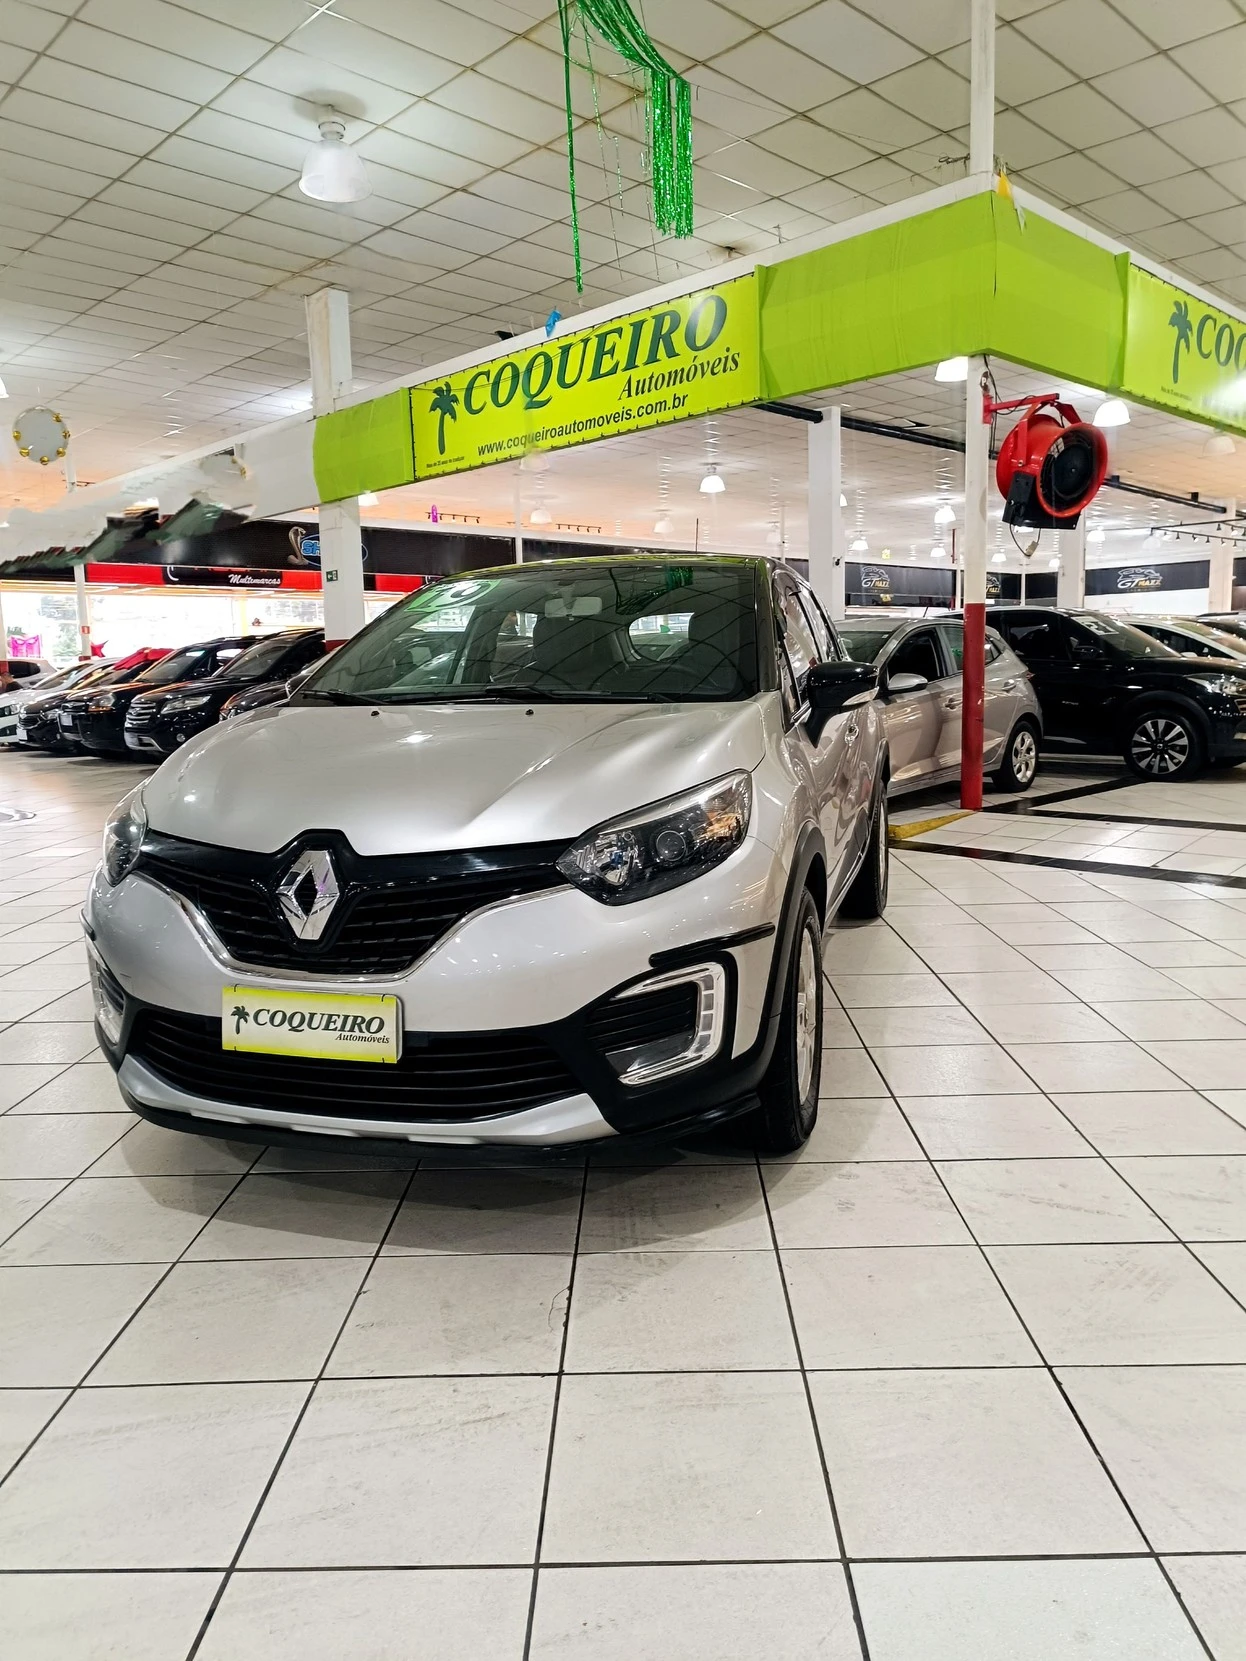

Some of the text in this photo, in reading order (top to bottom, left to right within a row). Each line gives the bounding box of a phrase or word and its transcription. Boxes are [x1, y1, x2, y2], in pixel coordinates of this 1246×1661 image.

[464, 295, 728, 415] COQUEIRO
[618, 347, 740, 400] Automóveis
[477, 393, 688, 456] www.coqueiroautomoveis.com.br
[252, 1008, 385, 1035] COQUEIRO
[335, 1033, 390, 1044] Automóveis
